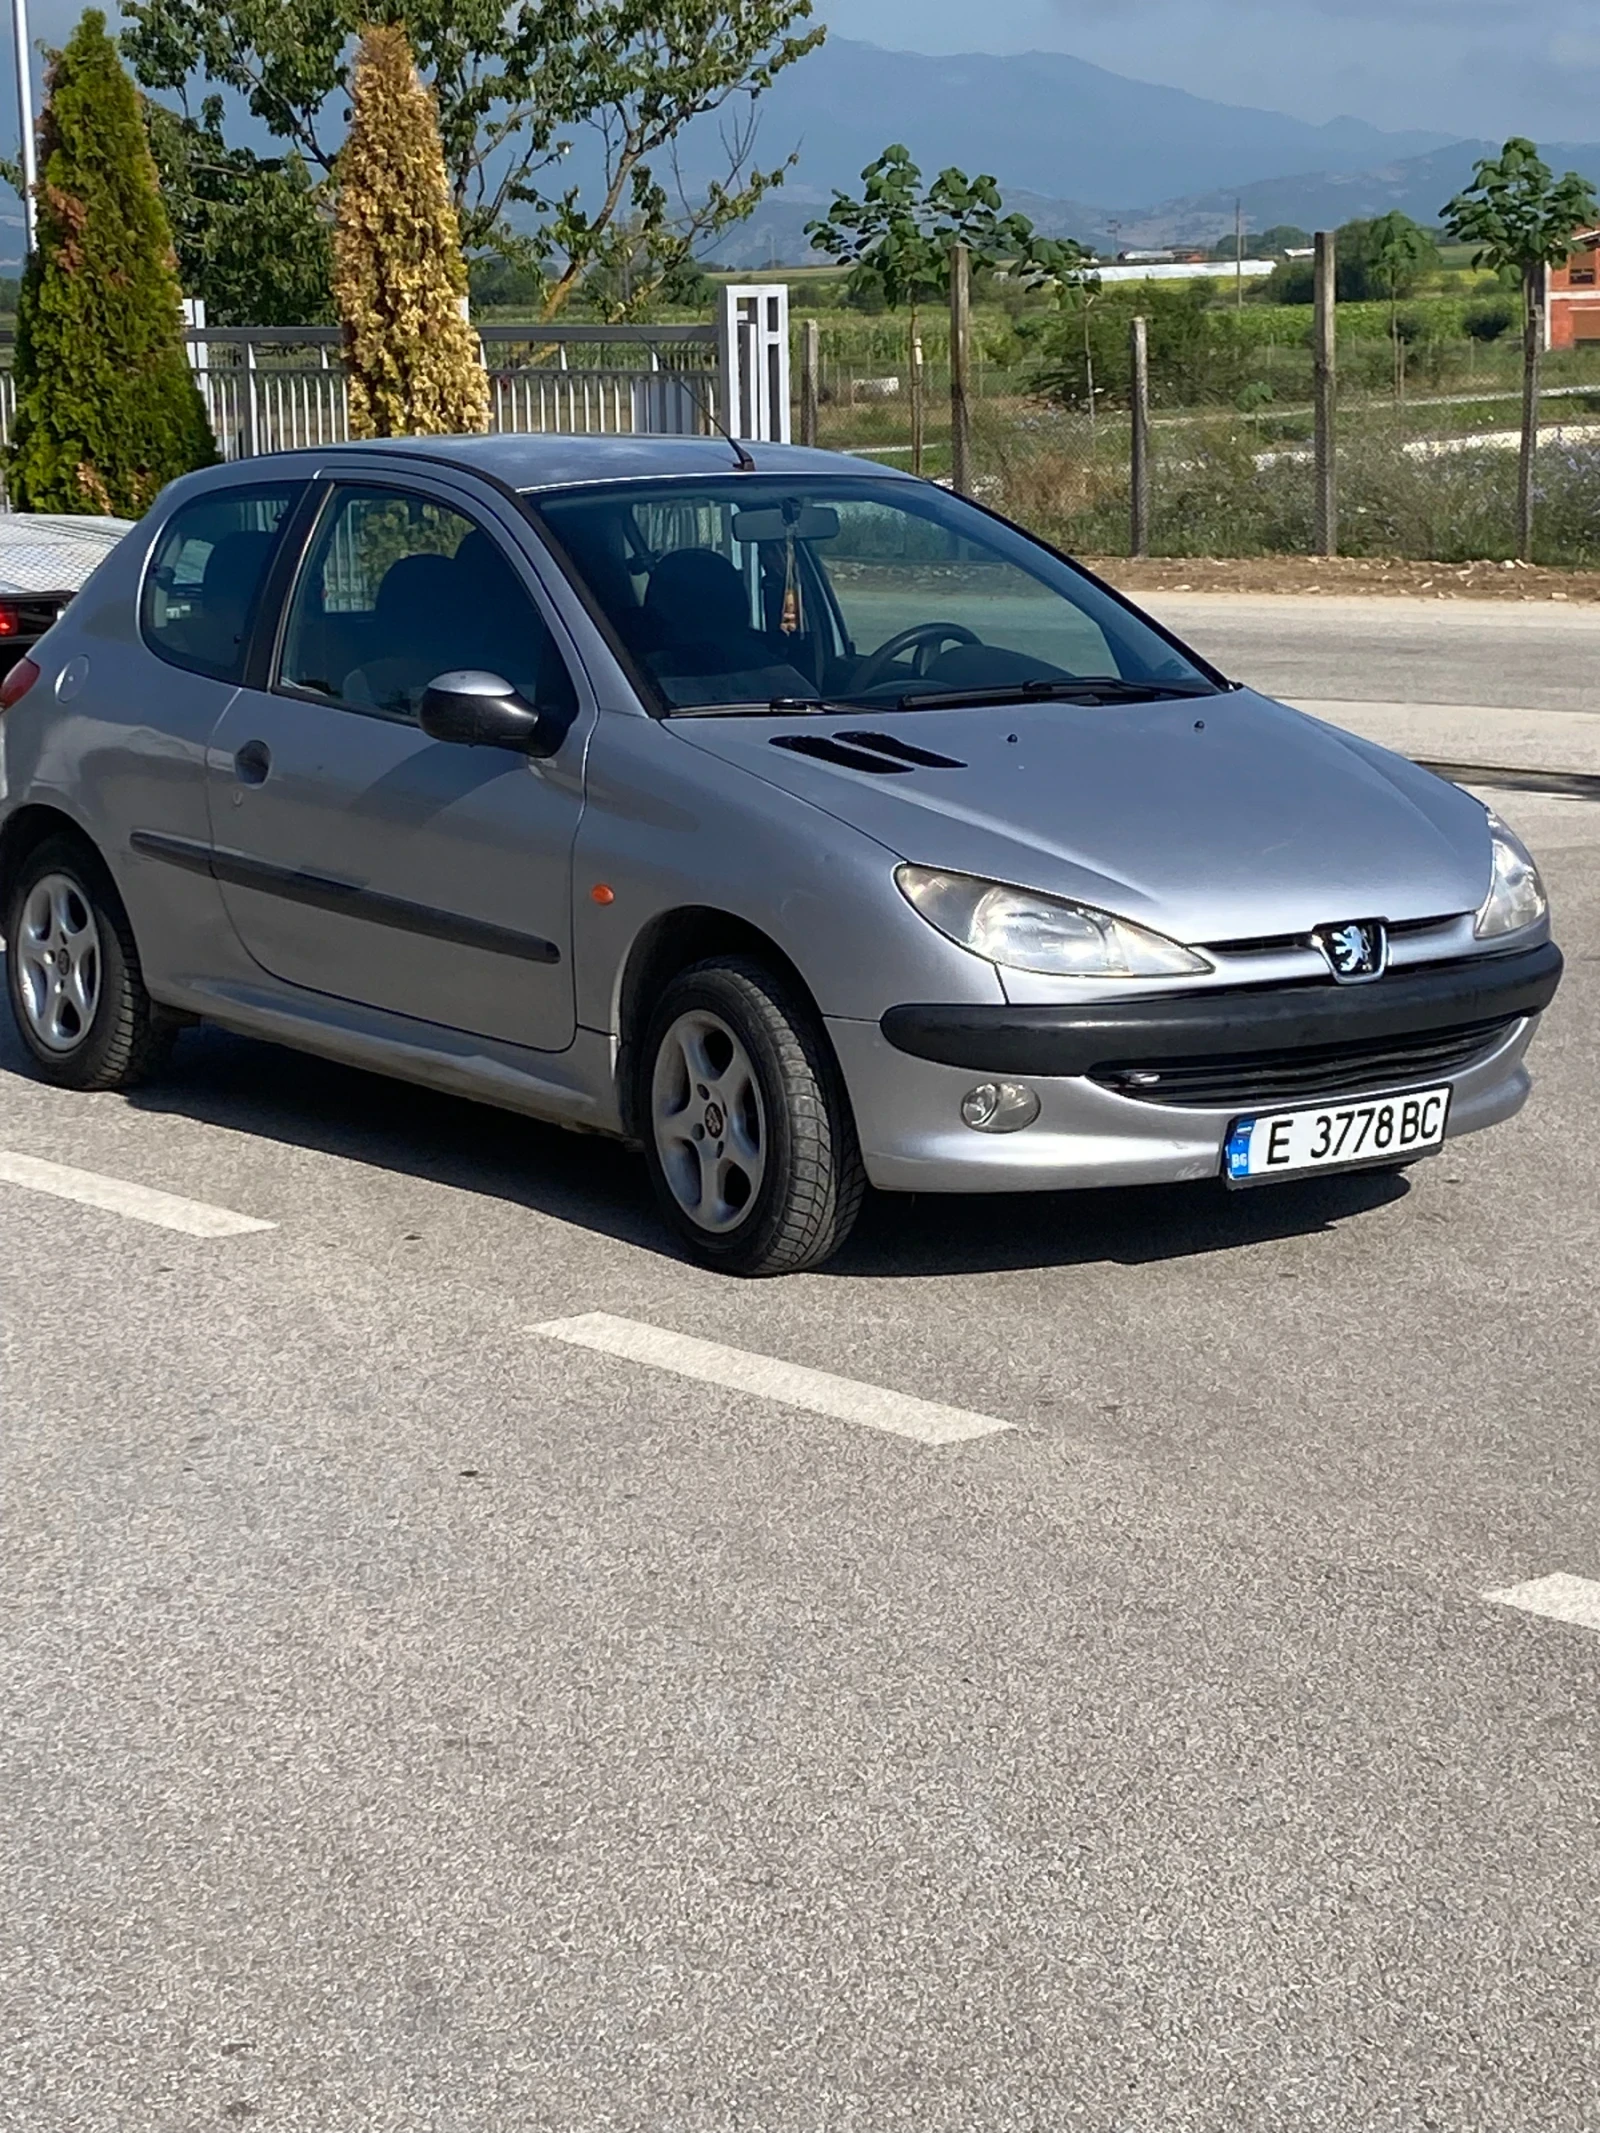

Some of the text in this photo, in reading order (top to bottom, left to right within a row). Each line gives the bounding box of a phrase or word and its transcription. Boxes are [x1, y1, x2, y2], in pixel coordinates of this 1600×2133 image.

[1267, 1097, 1440, 1165] E 3778 BC
[1232, 1153, 1247, 1168] BG
